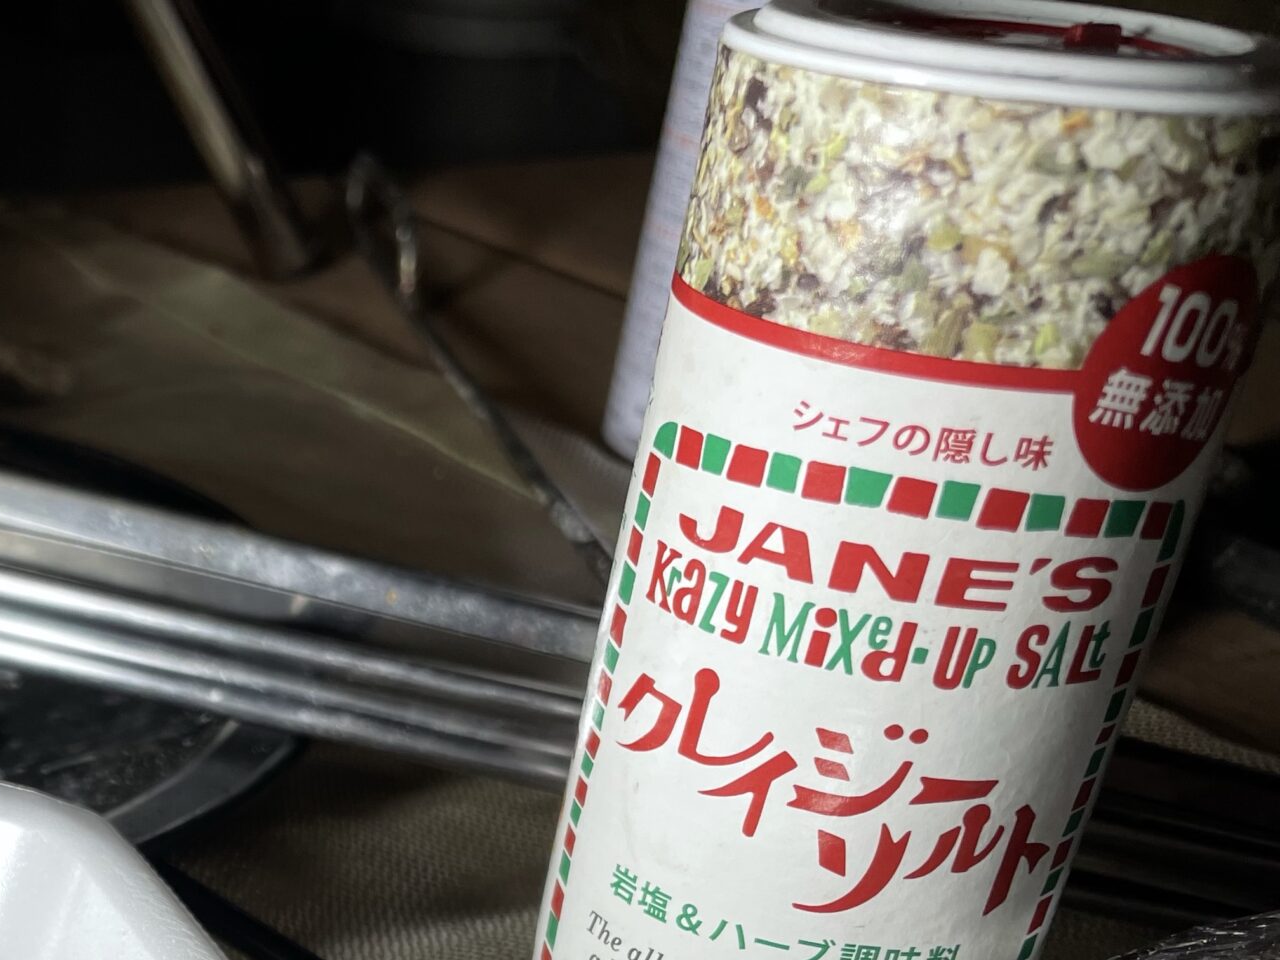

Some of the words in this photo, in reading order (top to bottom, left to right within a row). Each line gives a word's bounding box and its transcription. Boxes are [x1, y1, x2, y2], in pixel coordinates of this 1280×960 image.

[791, 399, 1055, 472] シェフの隠し味
[1088, 366, 1223, 440] 無添加
[645, 539, 759, 645] Krazy
[678, 505, 1120, 613] JANE'S
[615, 667, 1000, 838] クレイジー
[791, 804, 1051, 916] ソルト
[586, 910, 623, 952] The
